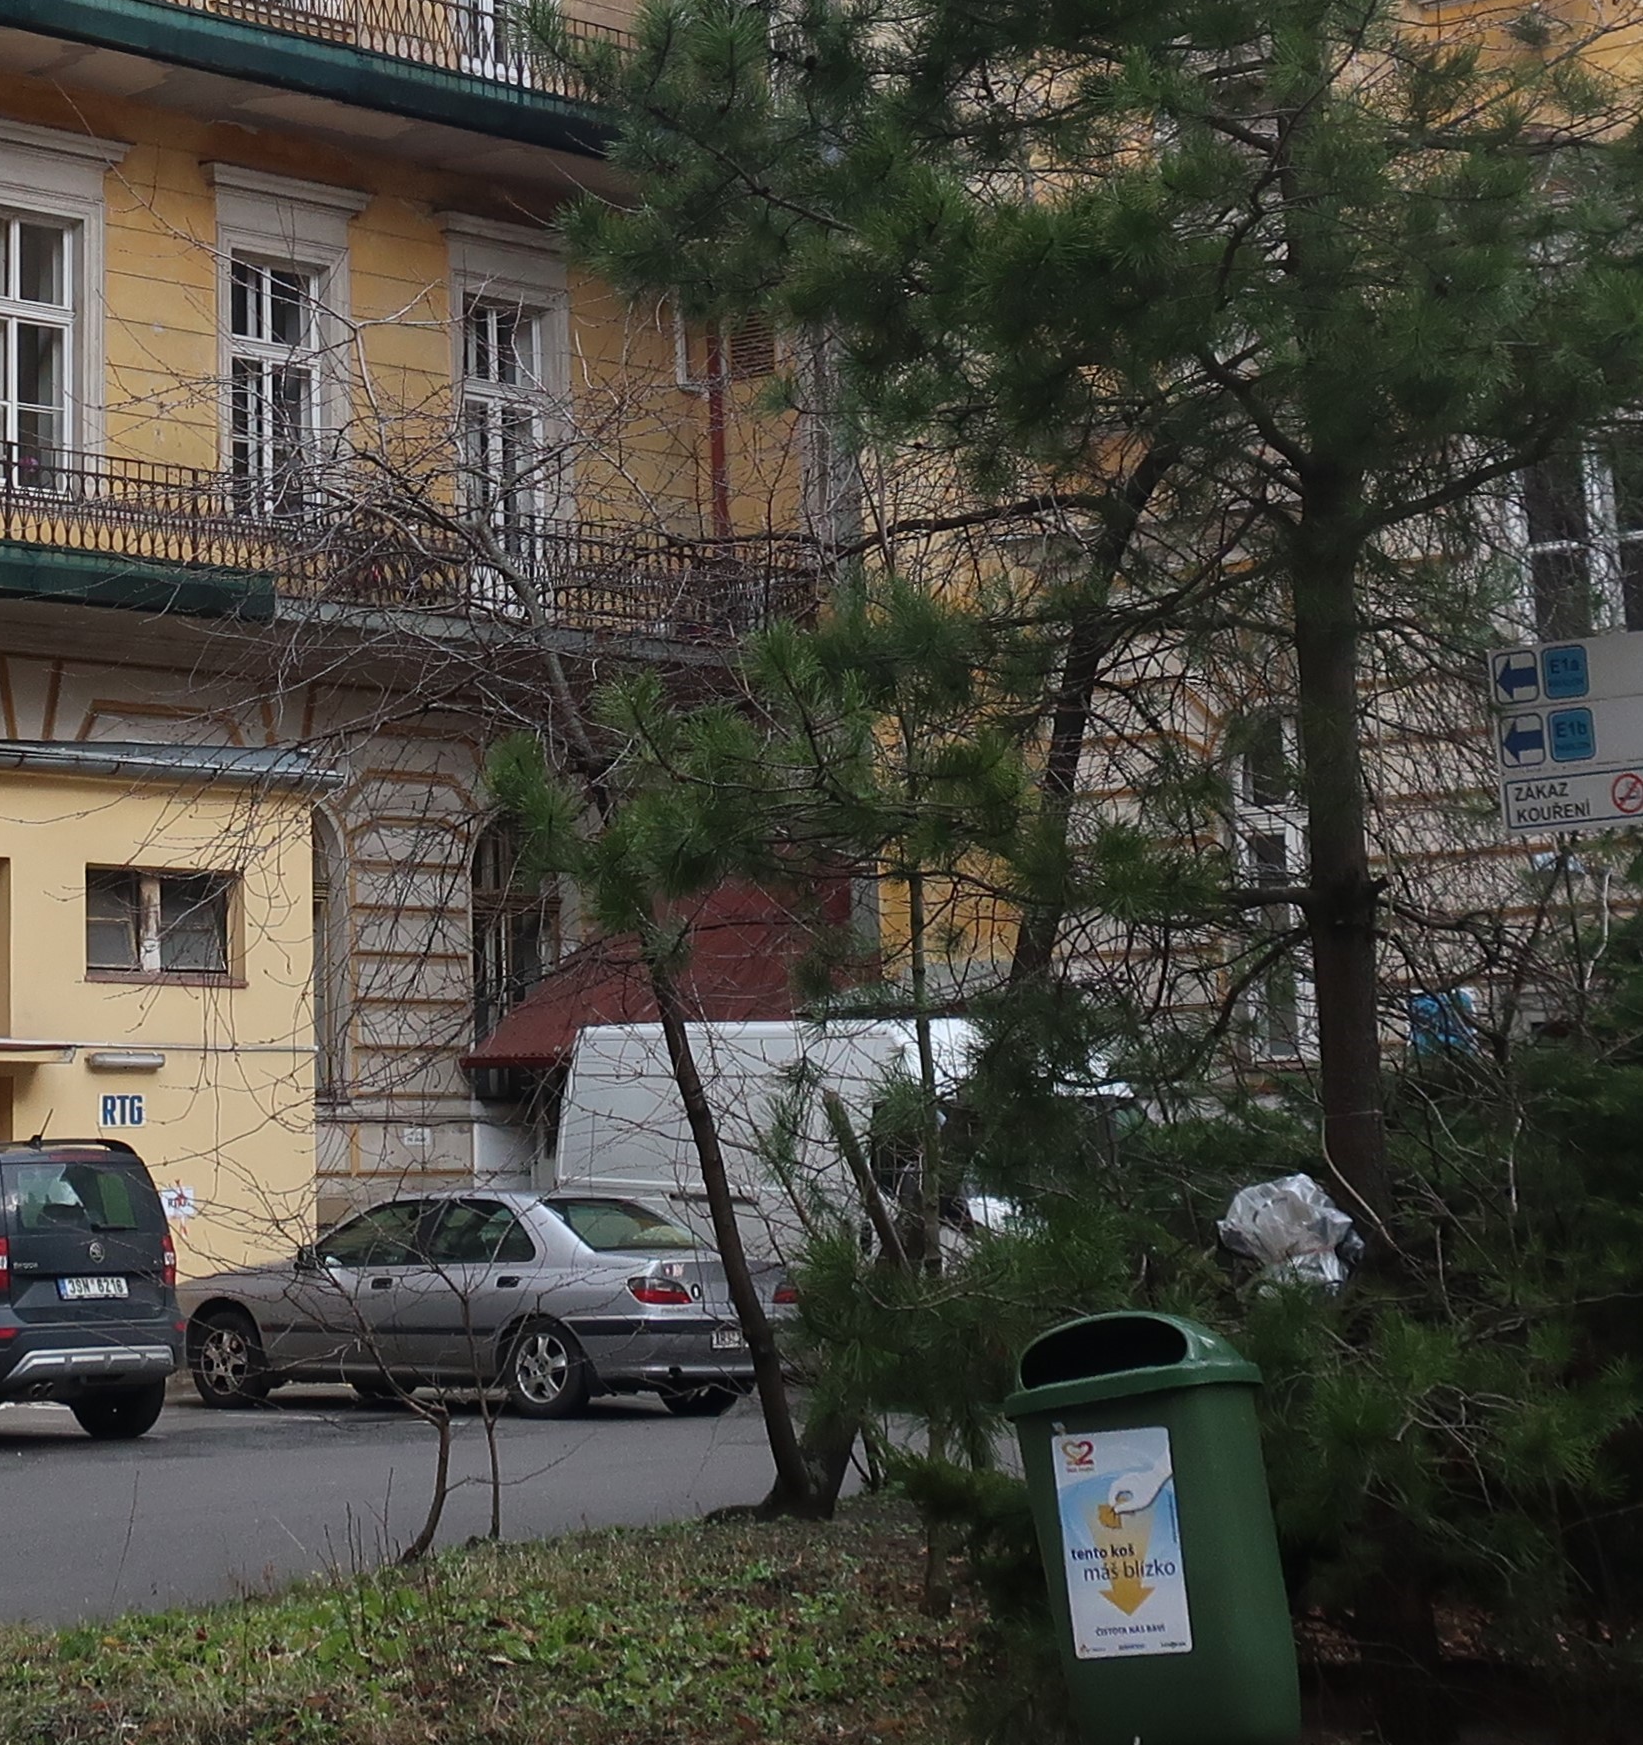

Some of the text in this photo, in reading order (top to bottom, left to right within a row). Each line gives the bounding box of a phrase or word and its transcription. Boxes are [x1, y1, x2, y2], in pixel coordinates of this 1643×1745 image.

[1556, 720, 1588, 738] E1b
[1514, 782, 1570, 802] ZÁKAZ
[1516, 797, 1591, 823] KOUŘENÍ
[102, 1095, 144, 1126] RTG
[1070, 1542, 1136, 1561] tento koš
[1083, 1558, 1176, 1582] máš blízko
